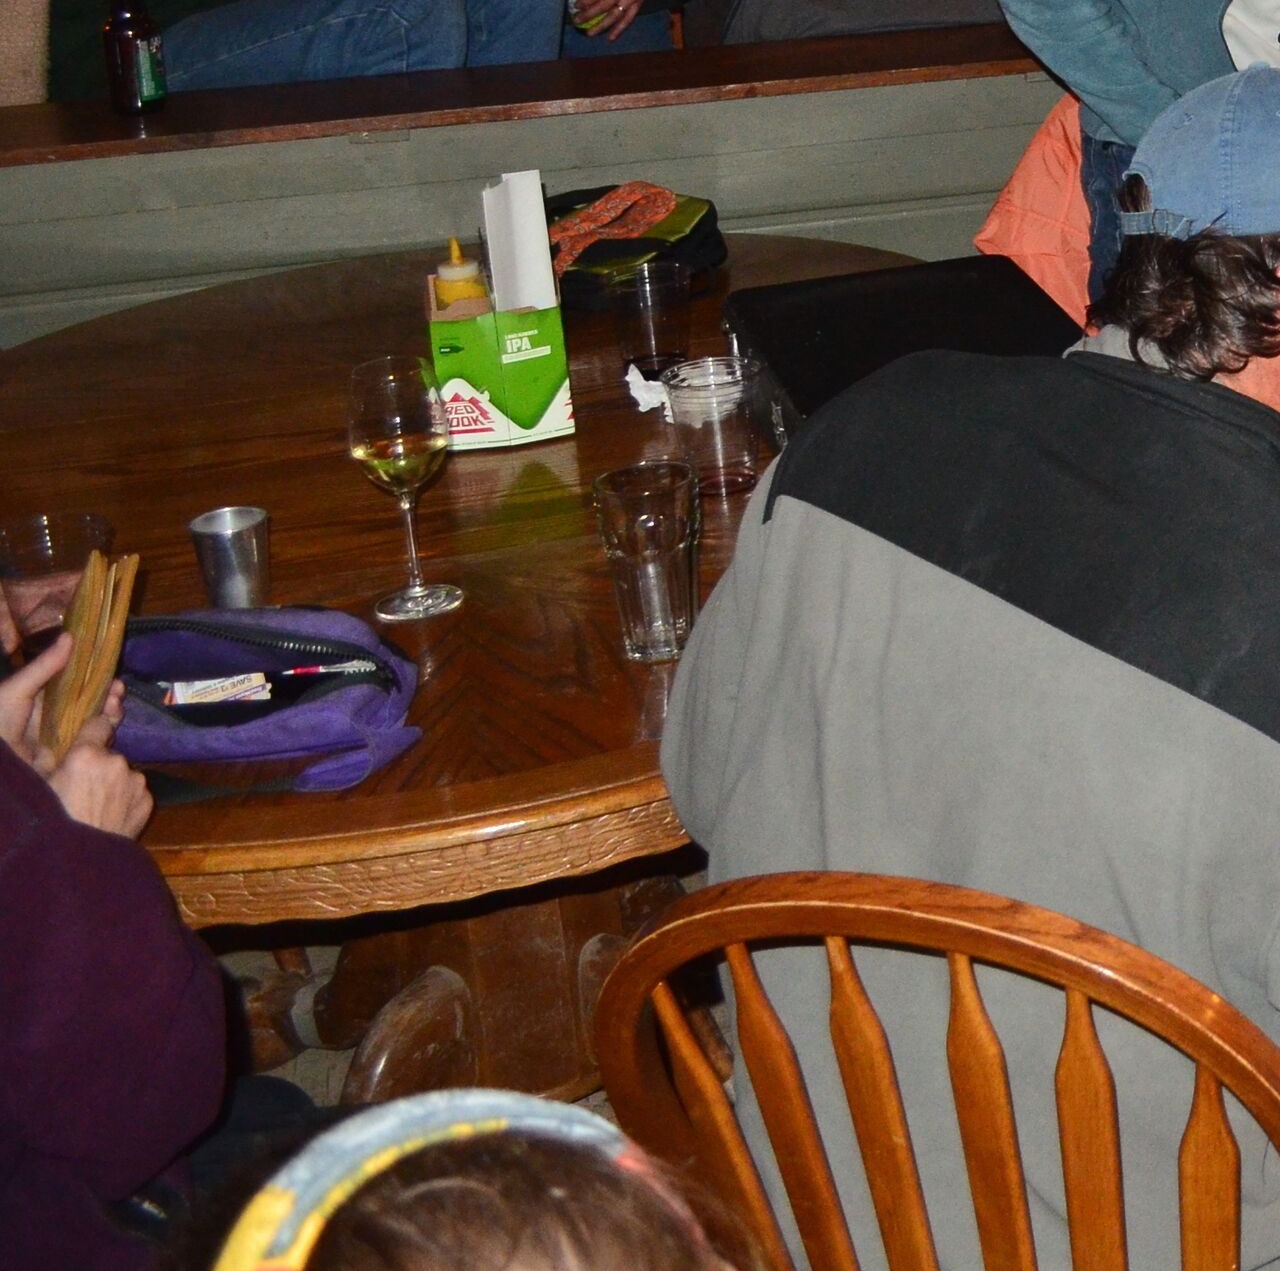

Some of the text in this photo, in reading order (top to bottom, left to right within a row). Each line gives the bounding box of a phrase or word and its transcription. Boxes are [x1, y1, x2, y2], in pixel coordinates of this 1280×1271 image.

[506, 336, 532, 354] IPA
[446, 405, 476, 416] RED
[447, 416, 485, 428] OOK
[229, 676, 253, 690] SAVE
